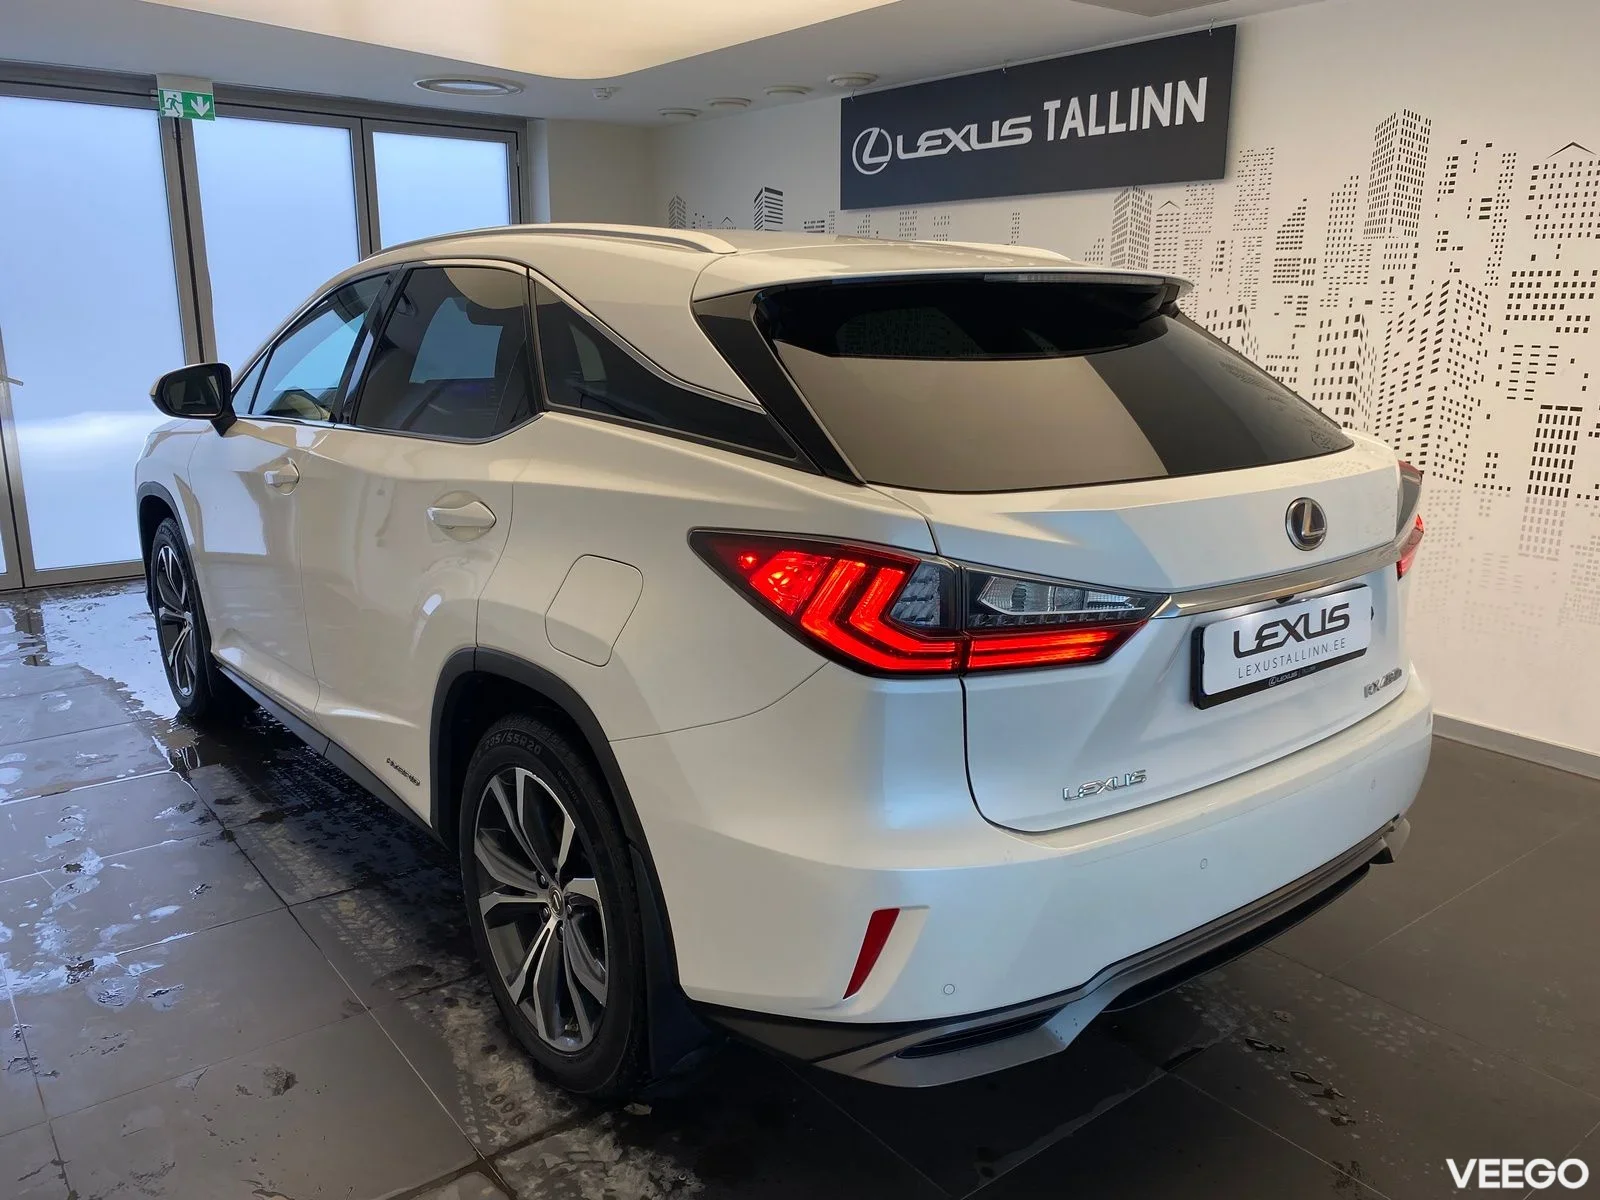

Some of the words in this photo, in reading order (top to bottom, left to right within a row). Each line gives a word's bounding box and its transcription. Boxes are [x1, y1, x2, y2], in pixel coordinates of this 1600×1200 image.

[896, 115, 1033, 160] LEXUS
[1043, 77, 1208, 142] TALLINN
[1233, 602, 1351, 659] LEXUS
[1237, 637, 1347, 679] LEXUSTALLINN.EE
[1062, 768, 1148, 801] LEXUS
